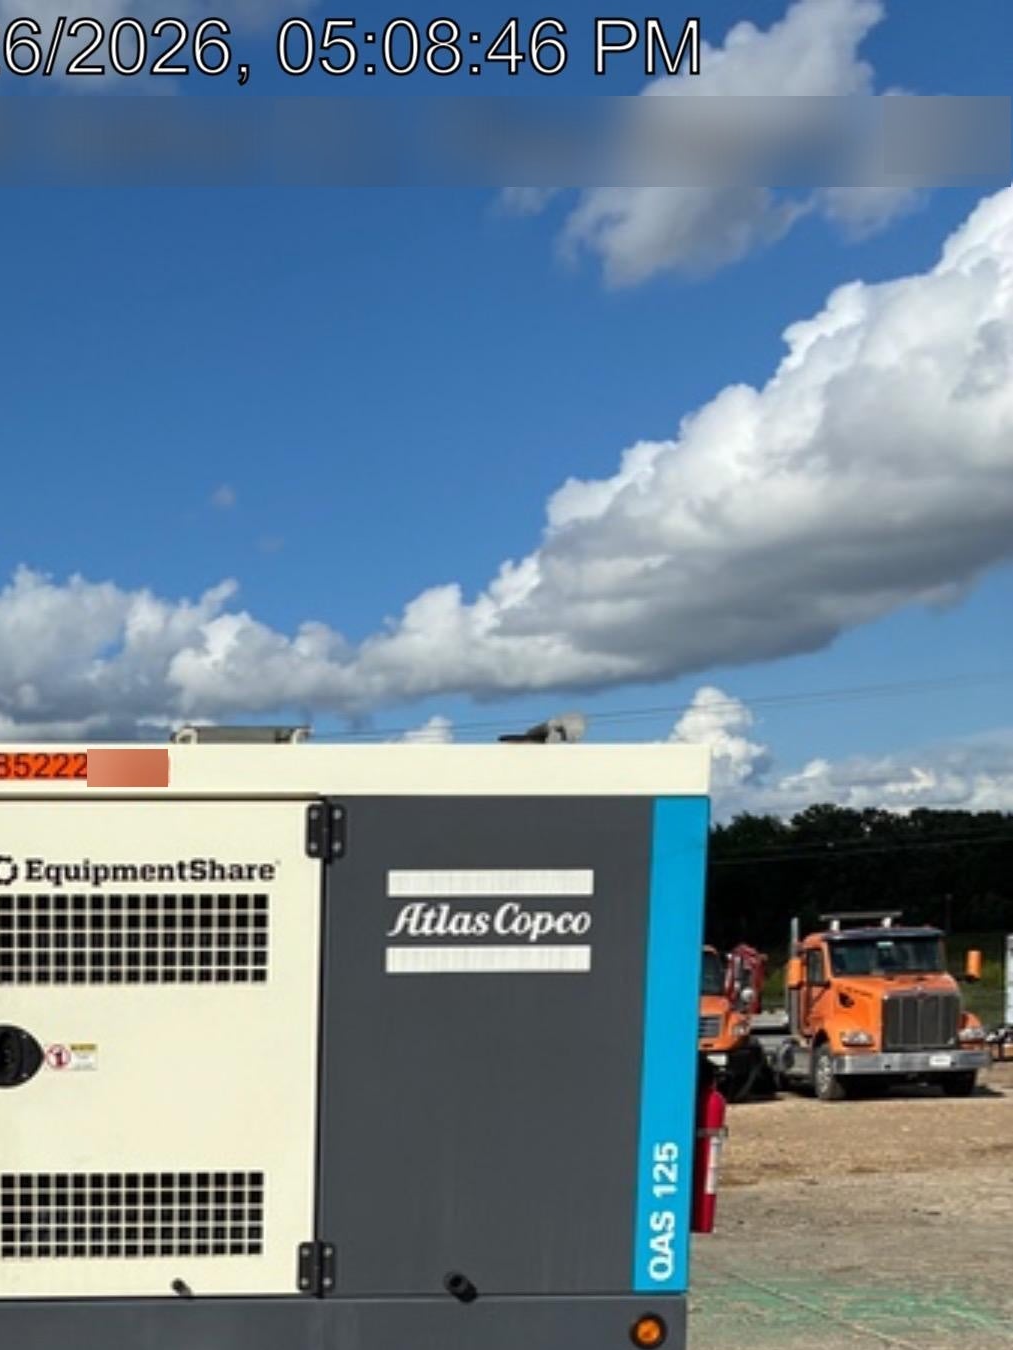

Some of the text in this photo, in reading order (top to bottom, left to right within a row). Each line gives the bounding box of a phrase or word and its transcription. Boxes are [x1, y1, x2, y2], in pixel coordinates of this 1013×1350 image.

[24, 859, 276, 885] EquipmentShare
[387, 902, 592, 942] Atlas Copco
[647, 1141, 679, 1281] QAS 125
